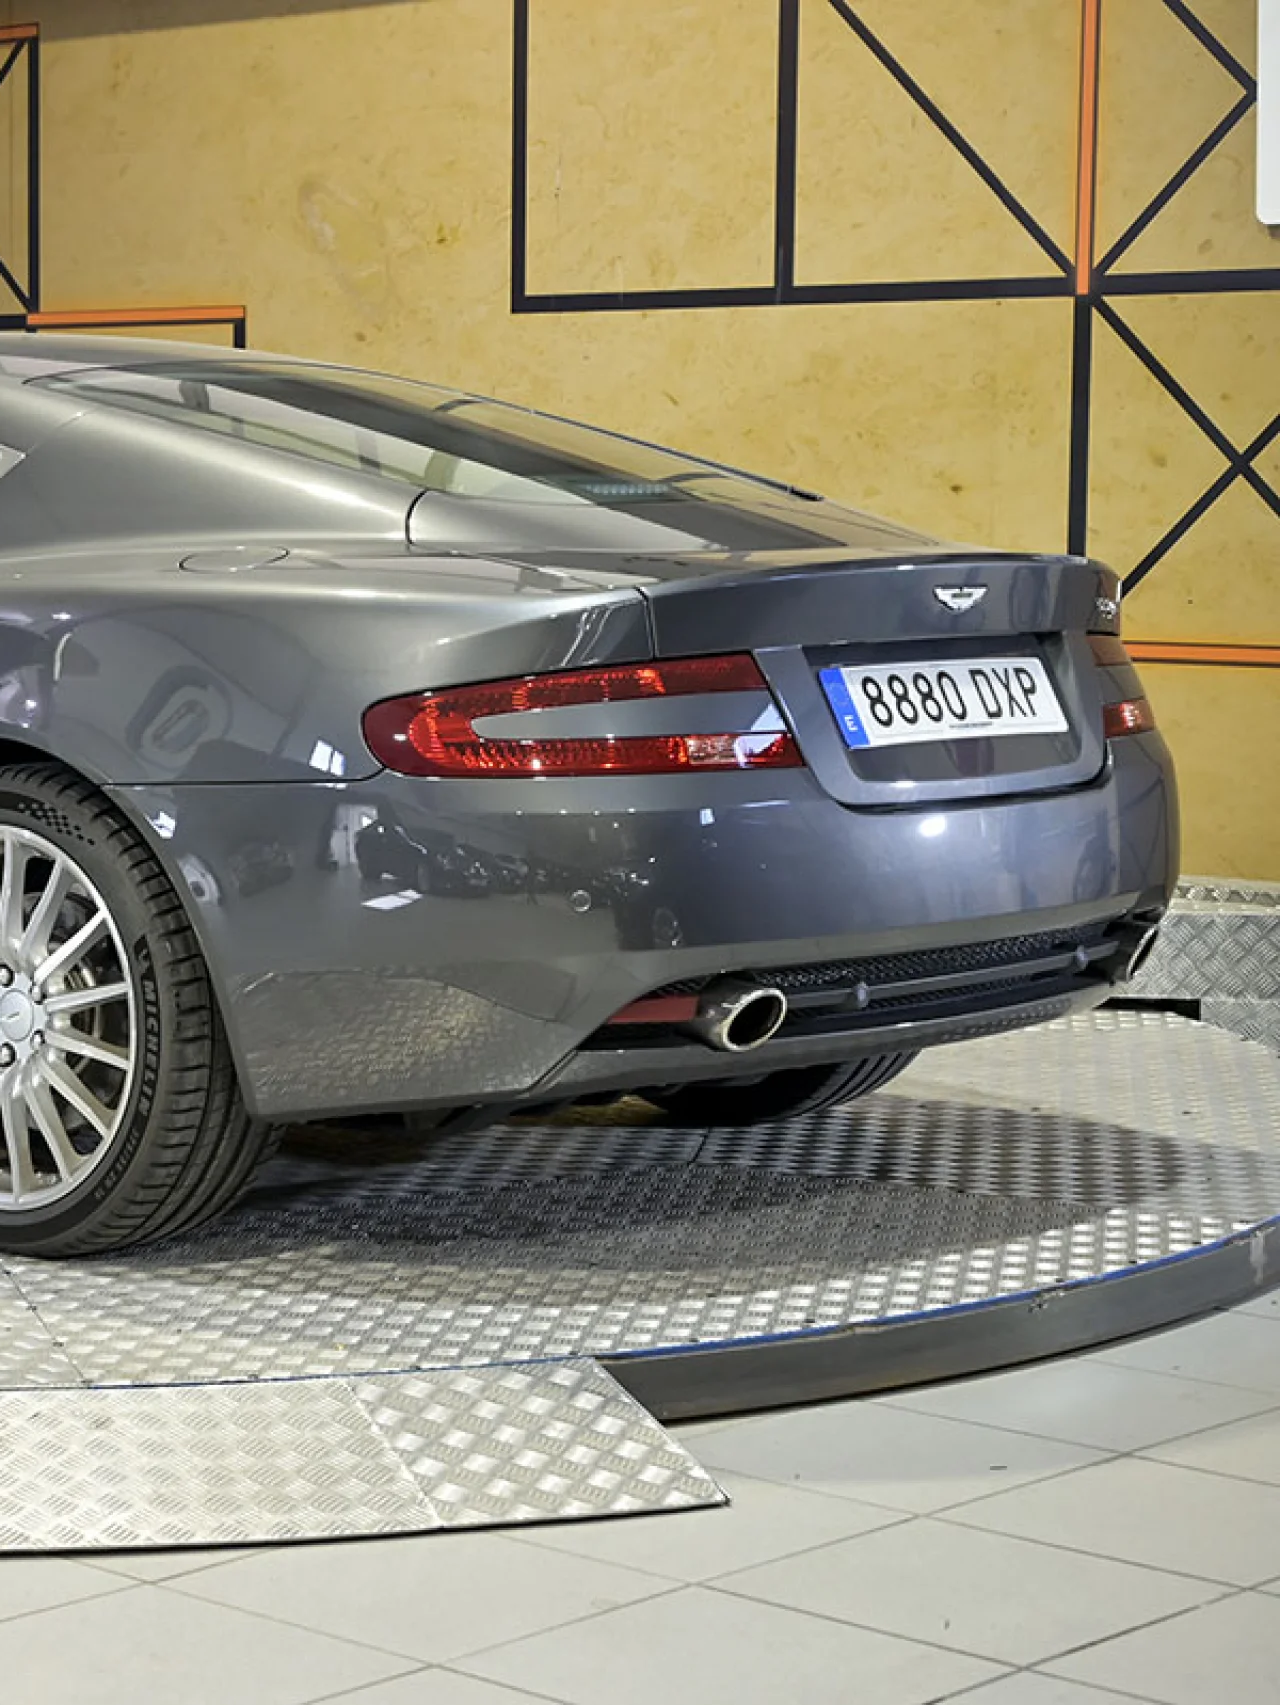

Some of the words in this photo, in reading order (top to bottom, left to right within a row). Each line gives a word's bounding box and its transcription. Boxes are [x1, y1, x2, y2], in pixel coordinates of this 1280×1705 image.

[861, 670, 967, 727] 8880
[969, 667, 1037, 719] DXP
[845, 715, 858, 731] E
